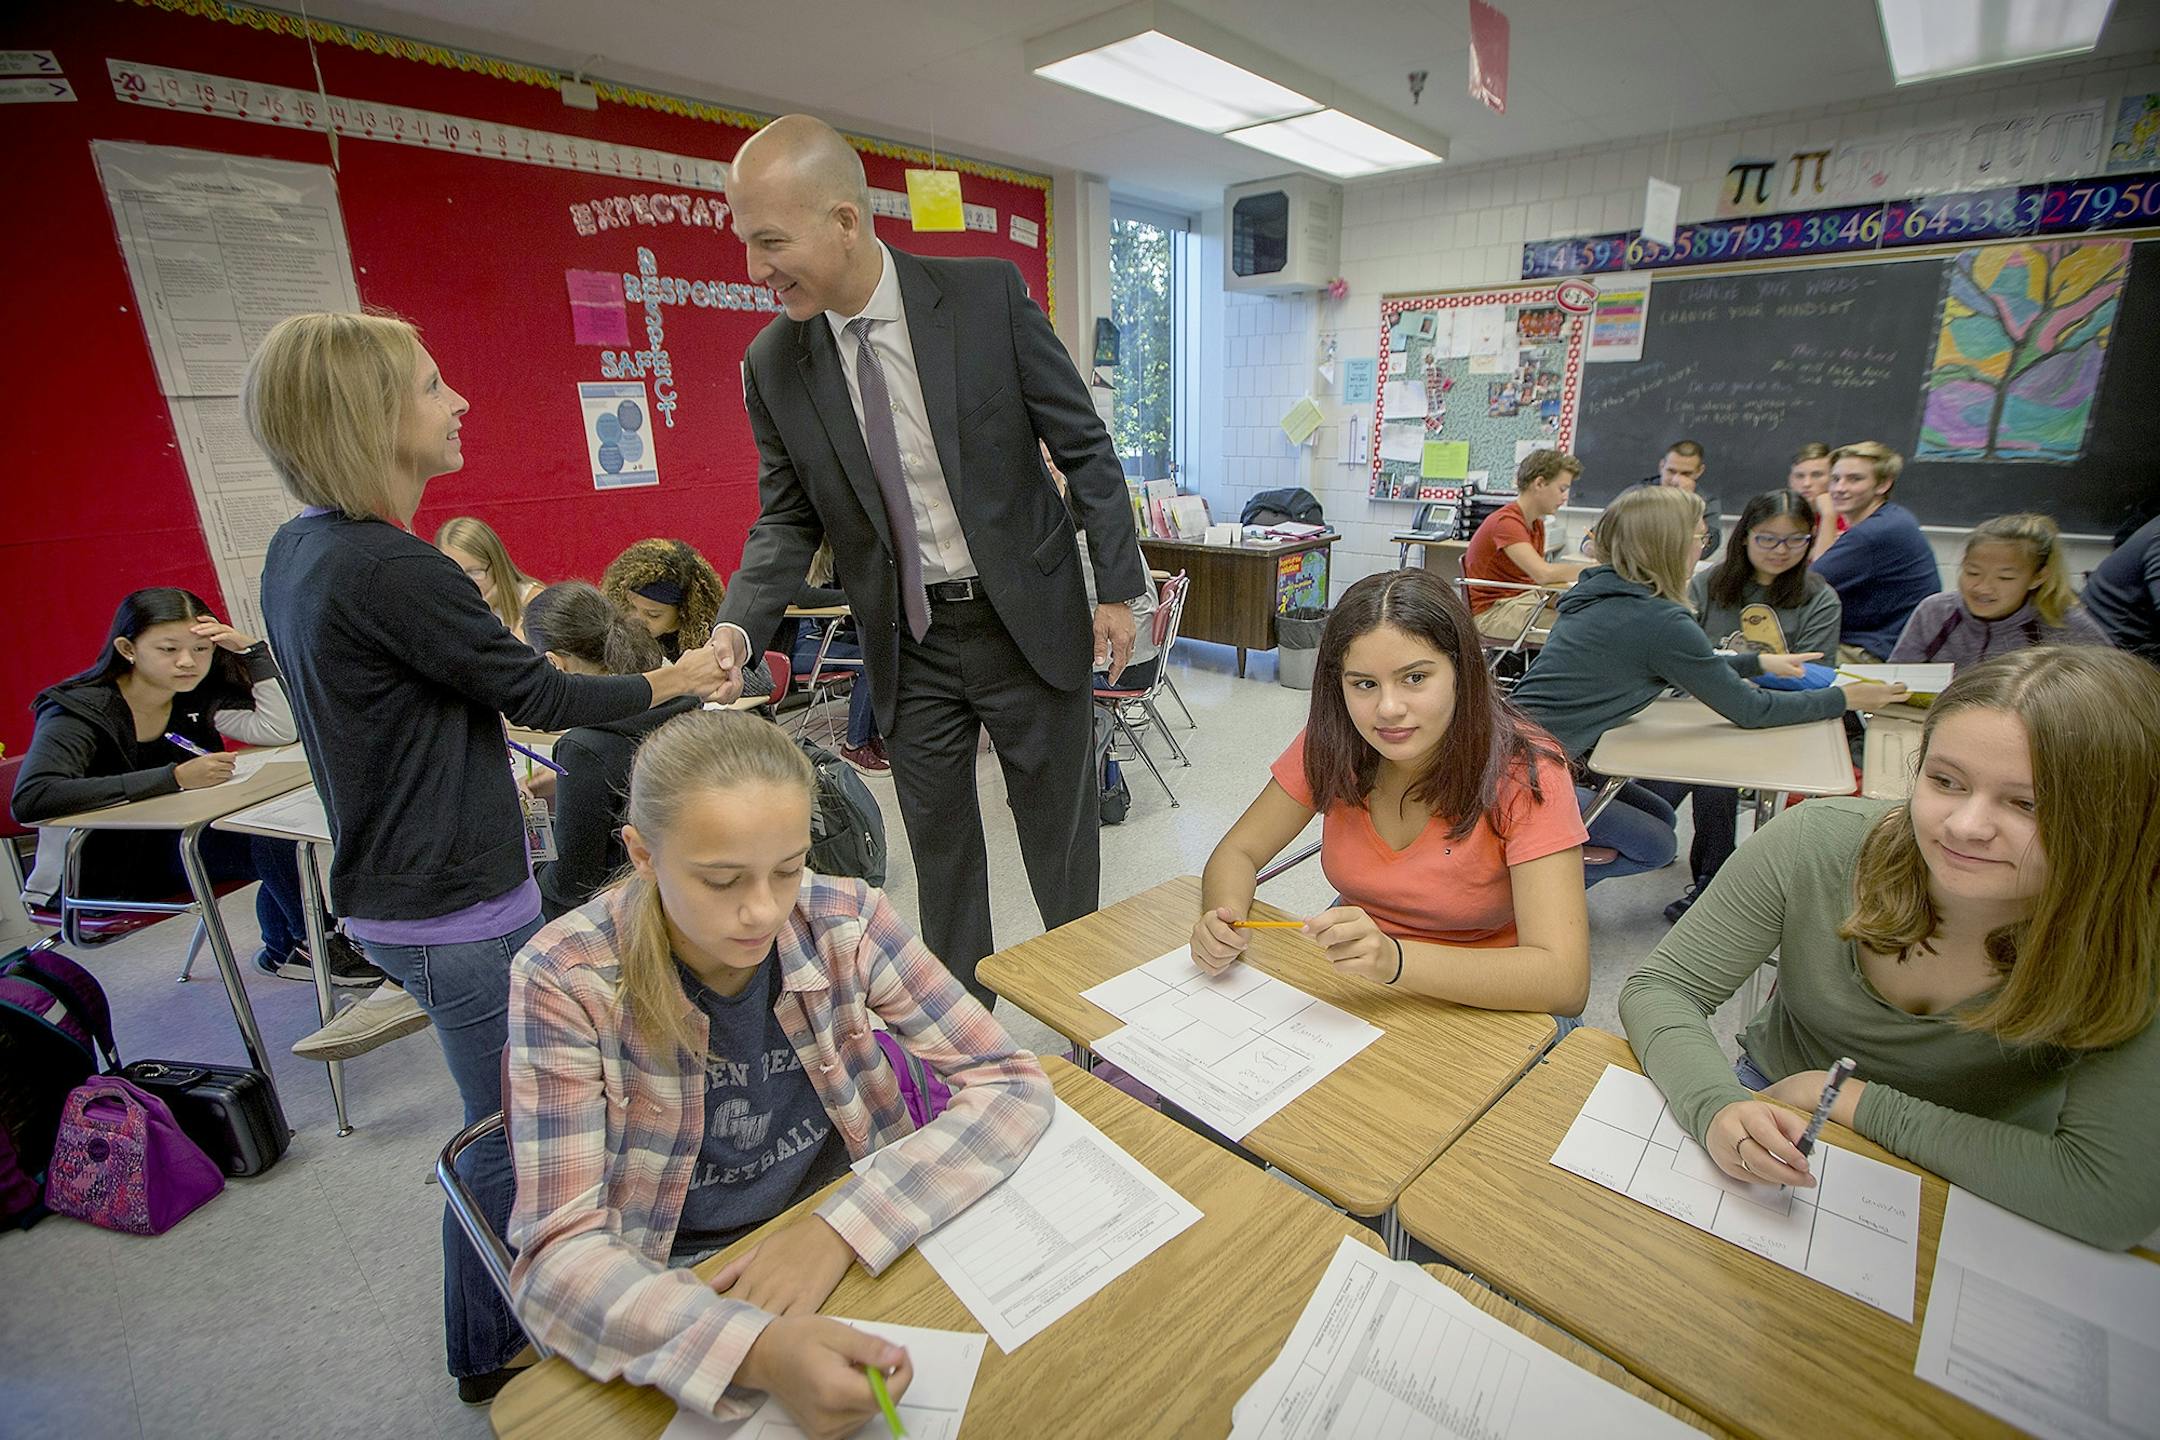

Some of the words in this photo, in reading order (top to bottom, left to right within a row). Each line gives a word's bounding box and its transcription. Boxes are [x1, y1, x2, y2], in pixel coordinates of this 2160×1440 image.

[113, 71, 146, 93] -20
[152, 77, 181, 97] -19
[188, 83, 218, 103] -18
[224, 89, 249, 109] -17
[258, 95, 285, 114] -16
[291, 100, 317, 119] -15
[354, 111, 377, 128] -13
[383, 115, 404, 133] -12
[411, 120, 431, 137] -11
[438, 124, 460, 142] -10
[467, 129, 482, 145] -9
[673, 162, 682, 176] 0
[637, 246, 678, 428] RESPECT
[1775, 298, 1857, 318] MINDSET
[601, 350, 671, 379] SAFE
